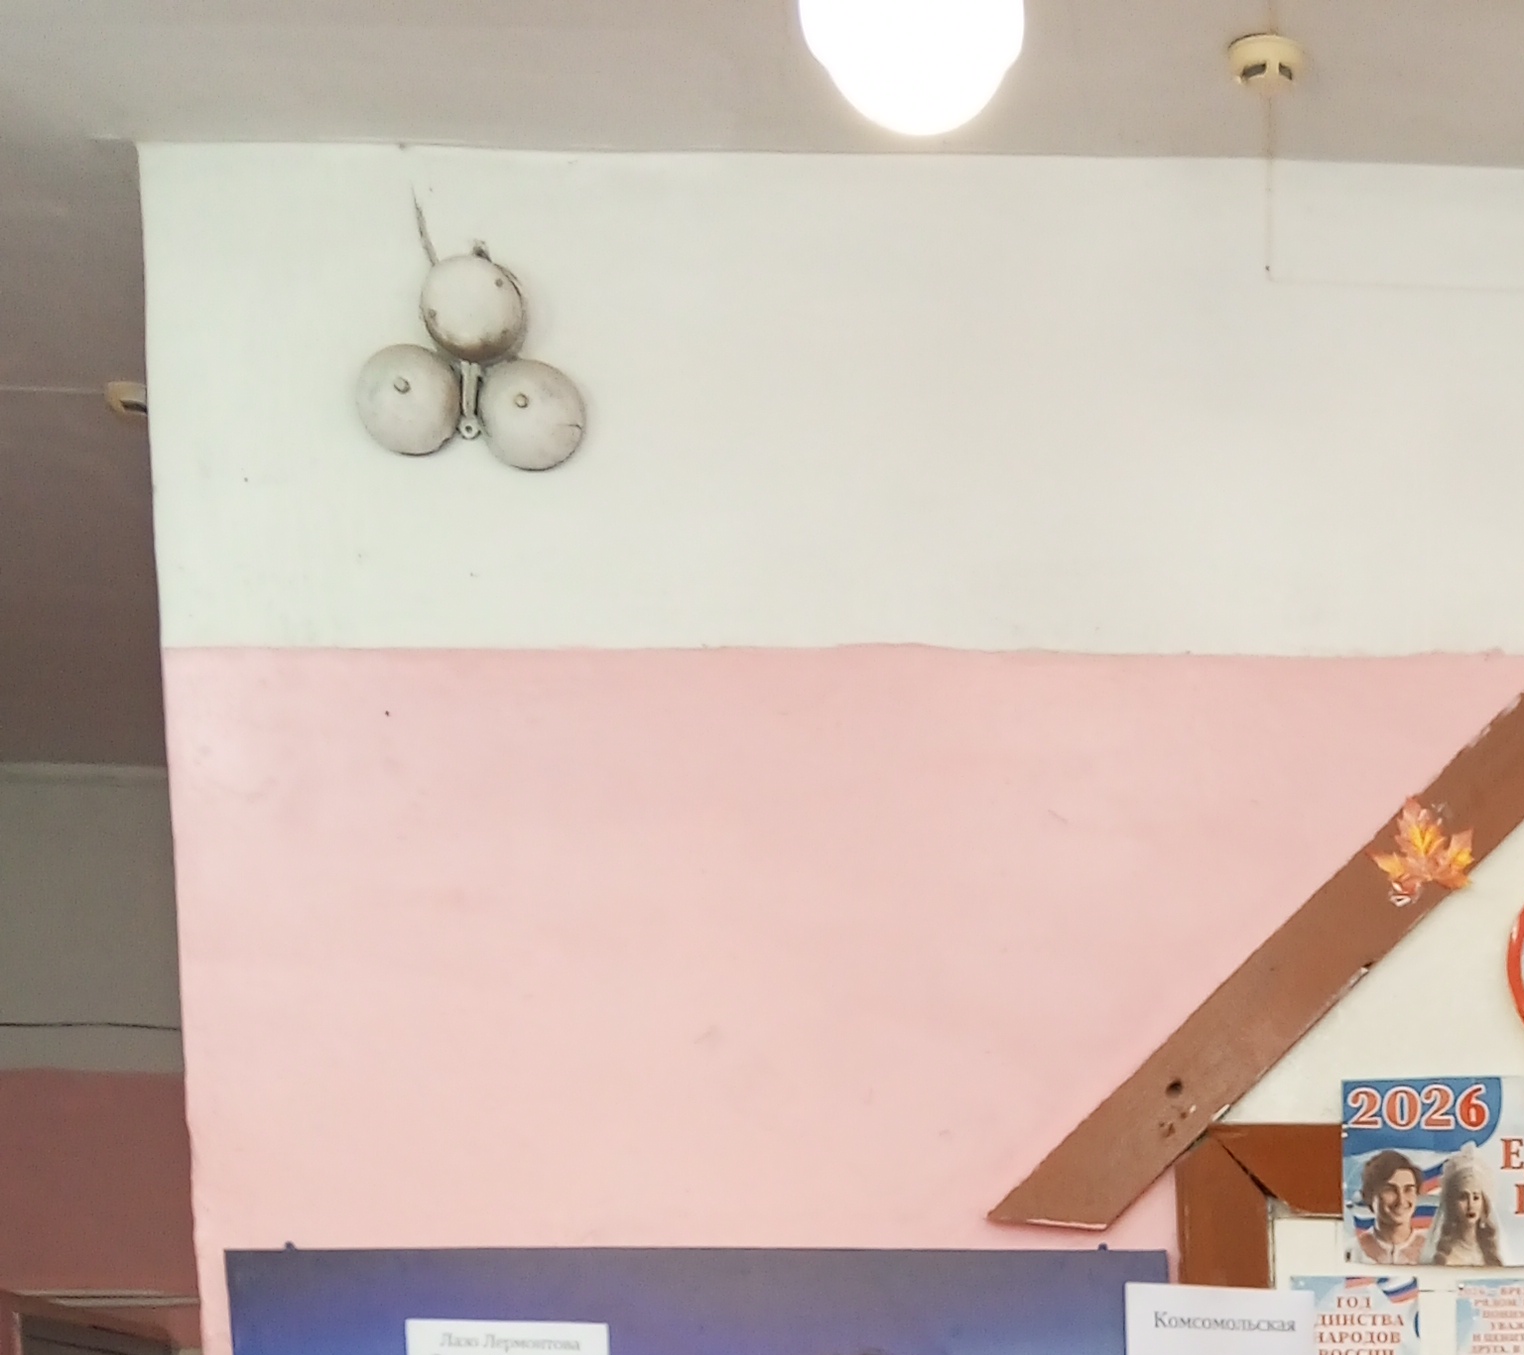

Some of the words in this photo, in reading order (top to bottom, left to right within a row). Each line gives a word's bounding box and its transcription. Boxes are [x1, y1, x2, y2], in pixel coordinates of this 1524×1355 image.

[1348, 1087, 1488, 1130] 2026
[1336, 1296, 1371, 1309] ГОД
[1153, 1310, 1297, 1332] Комсомольская
[1314, 1313, 1404, 1327] ДИНСТВА
